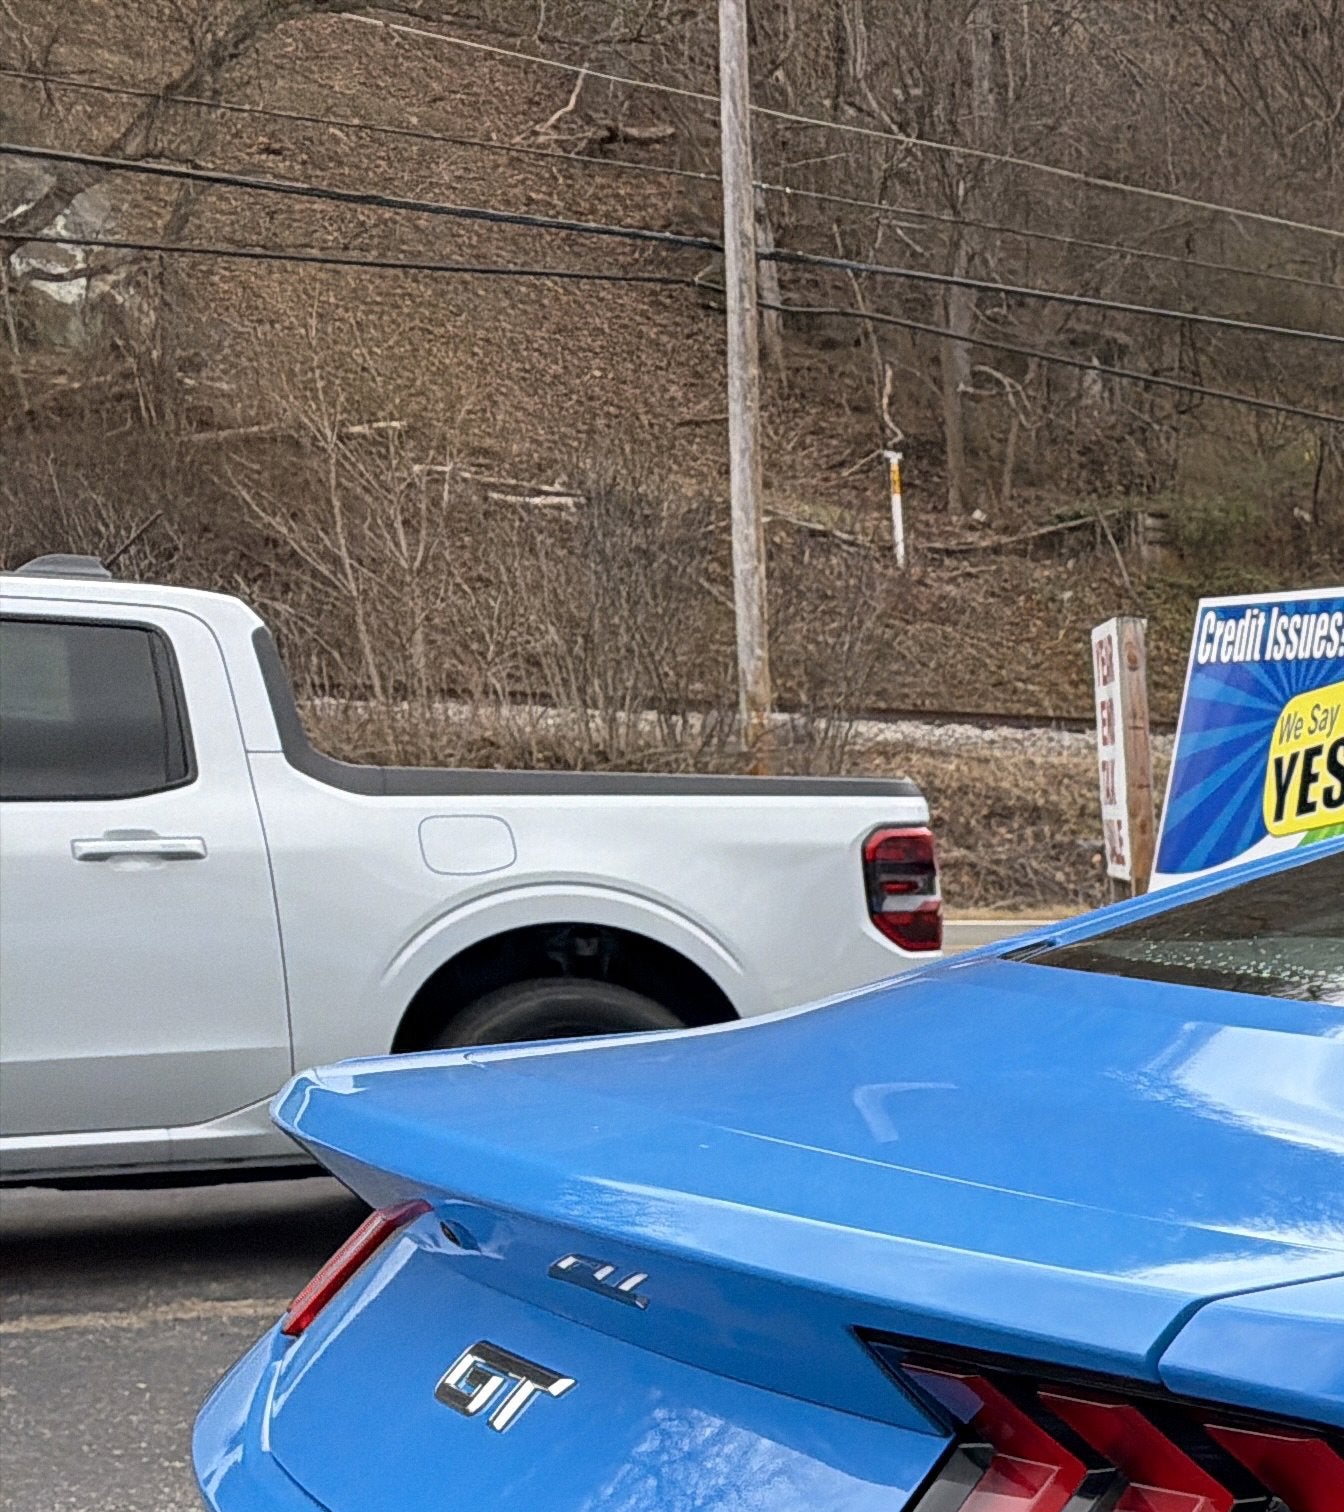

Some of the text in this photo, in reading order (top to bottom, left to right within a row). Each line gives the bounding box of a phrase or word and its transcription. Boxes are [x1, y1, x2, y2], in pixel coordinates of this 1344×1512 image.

[1198, 606, 1263, 666] Credit
[1278, 702, 1341, 743] We Say
[435, 1340, 577, 1433] GT
